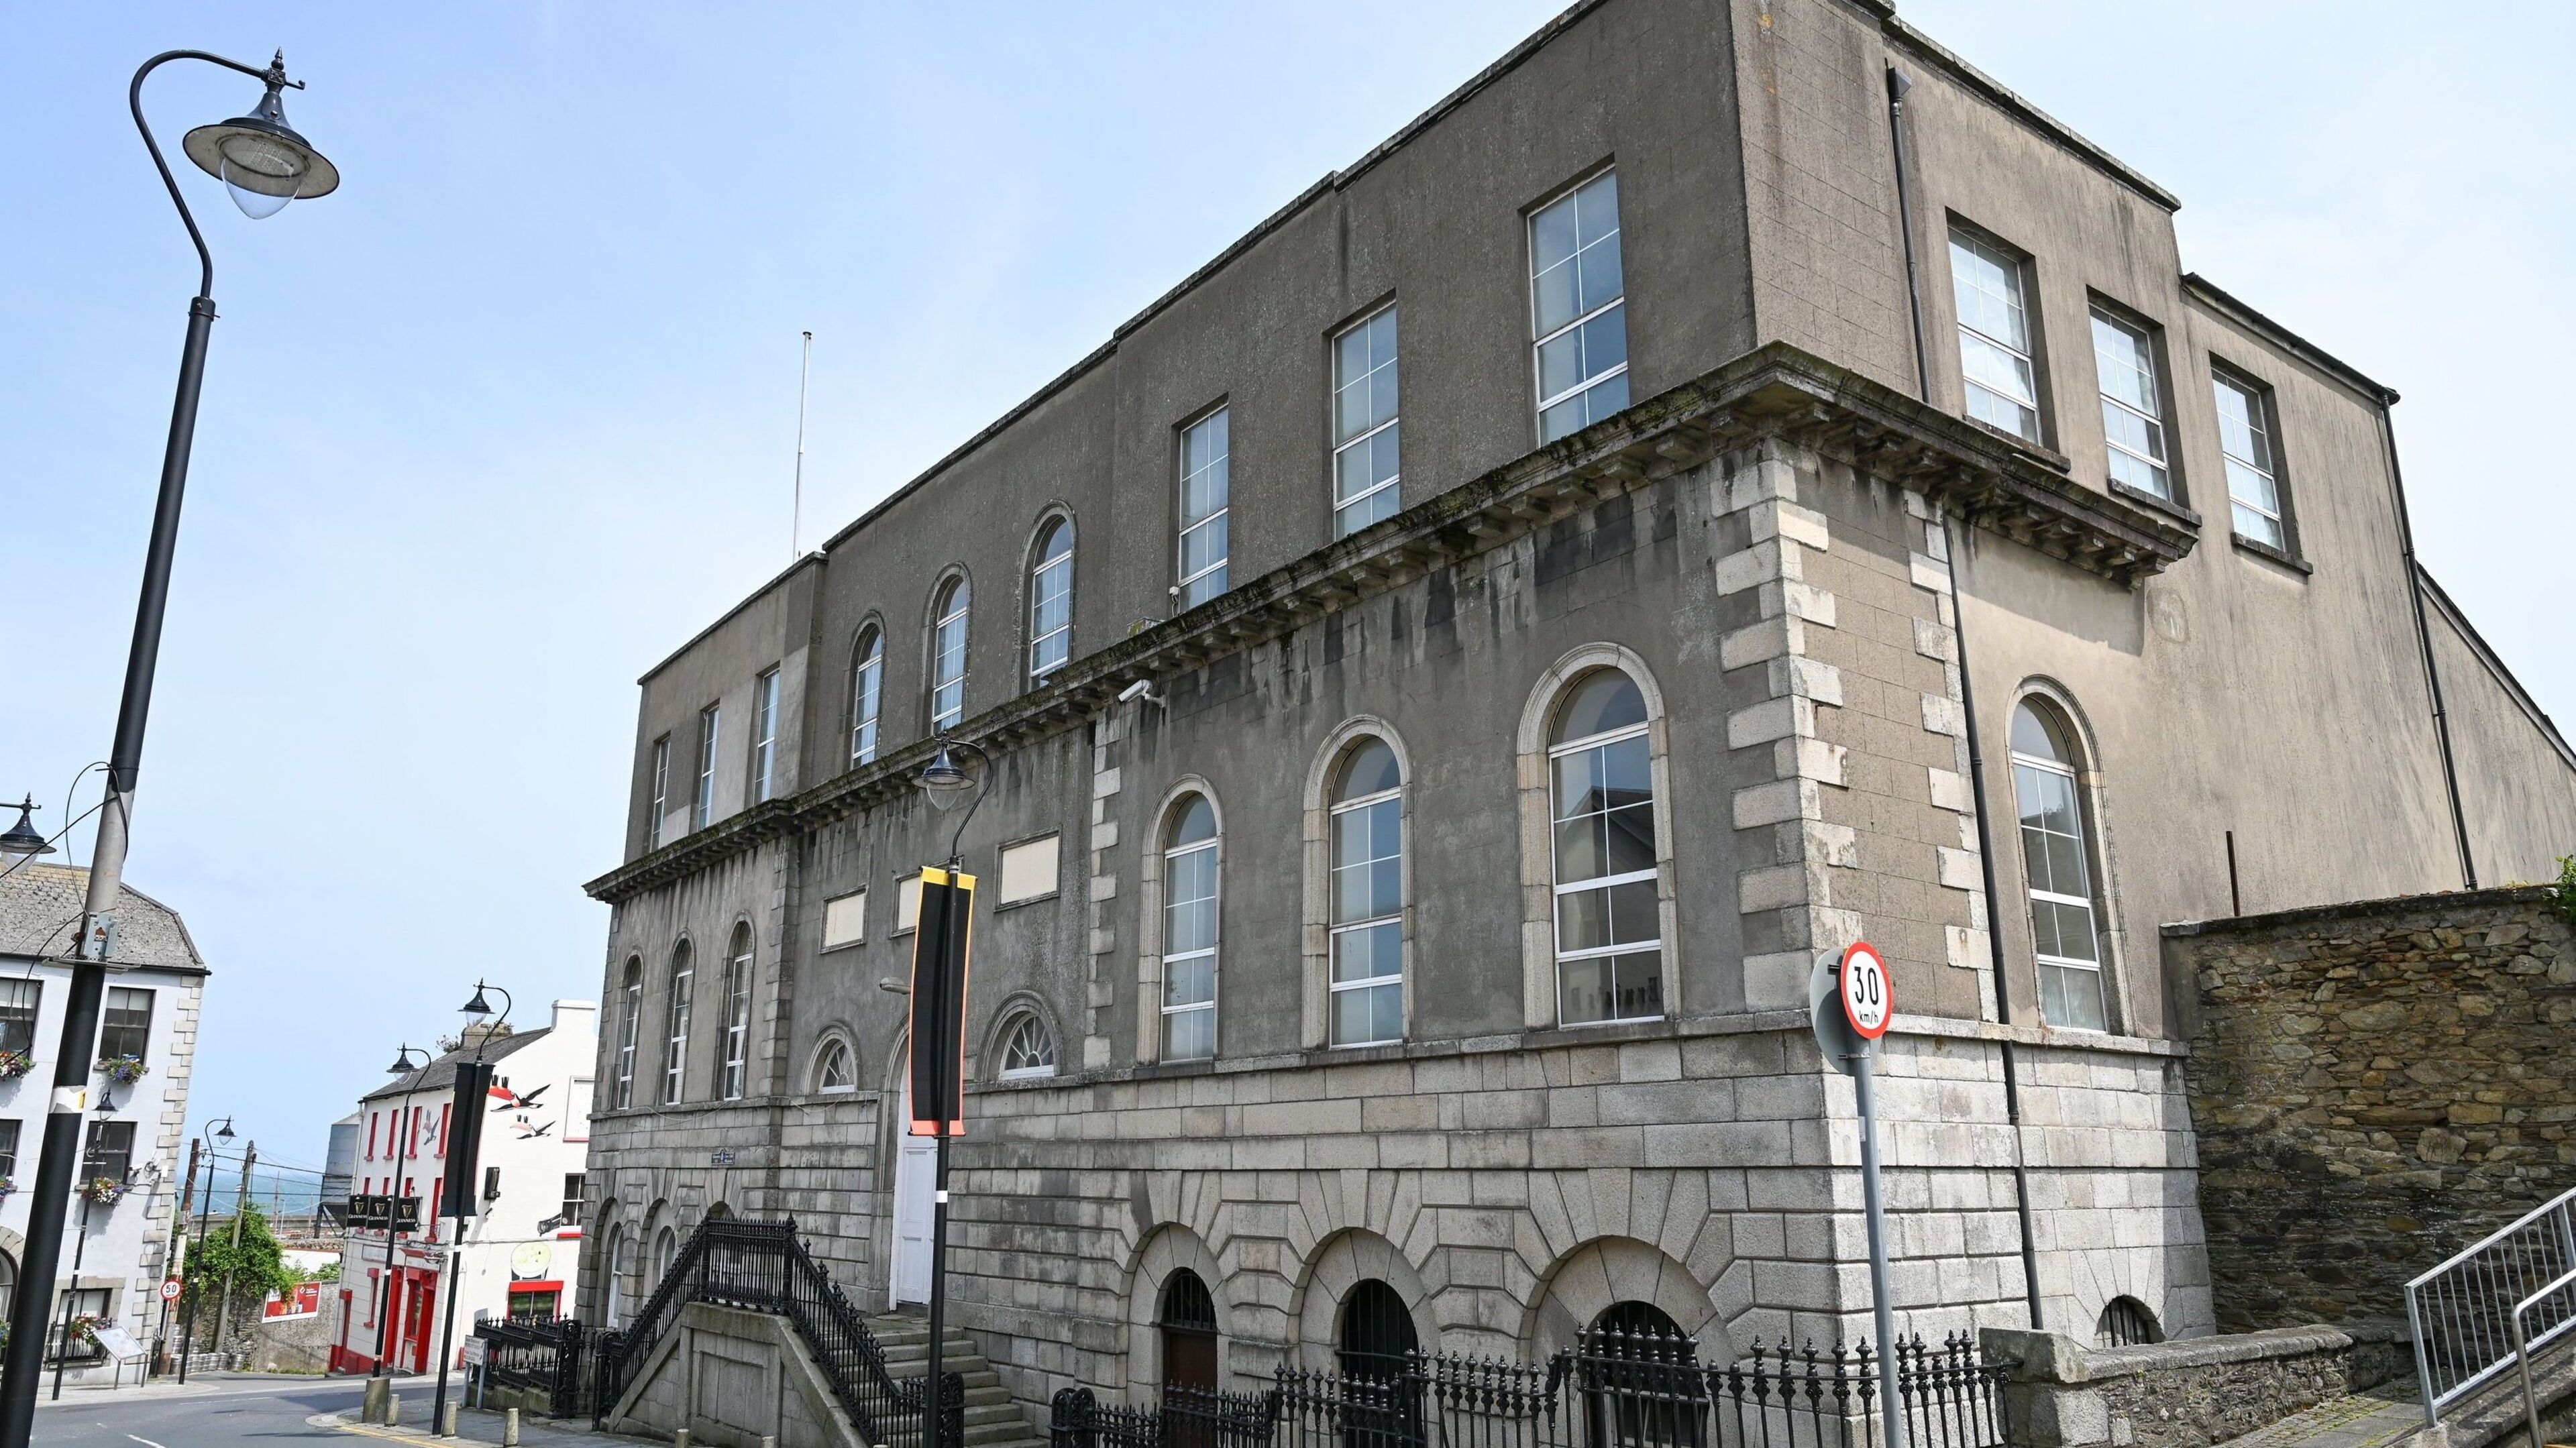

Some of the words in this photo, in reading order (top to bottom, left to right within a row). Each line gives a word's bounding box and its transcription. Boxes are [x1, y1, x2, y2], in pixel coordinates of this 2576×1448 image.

[1854, 966, 1879, 1005] 30
[1859, 1010, 1879, 1024] km/h
[166, 1284, 177, 1293] 50
